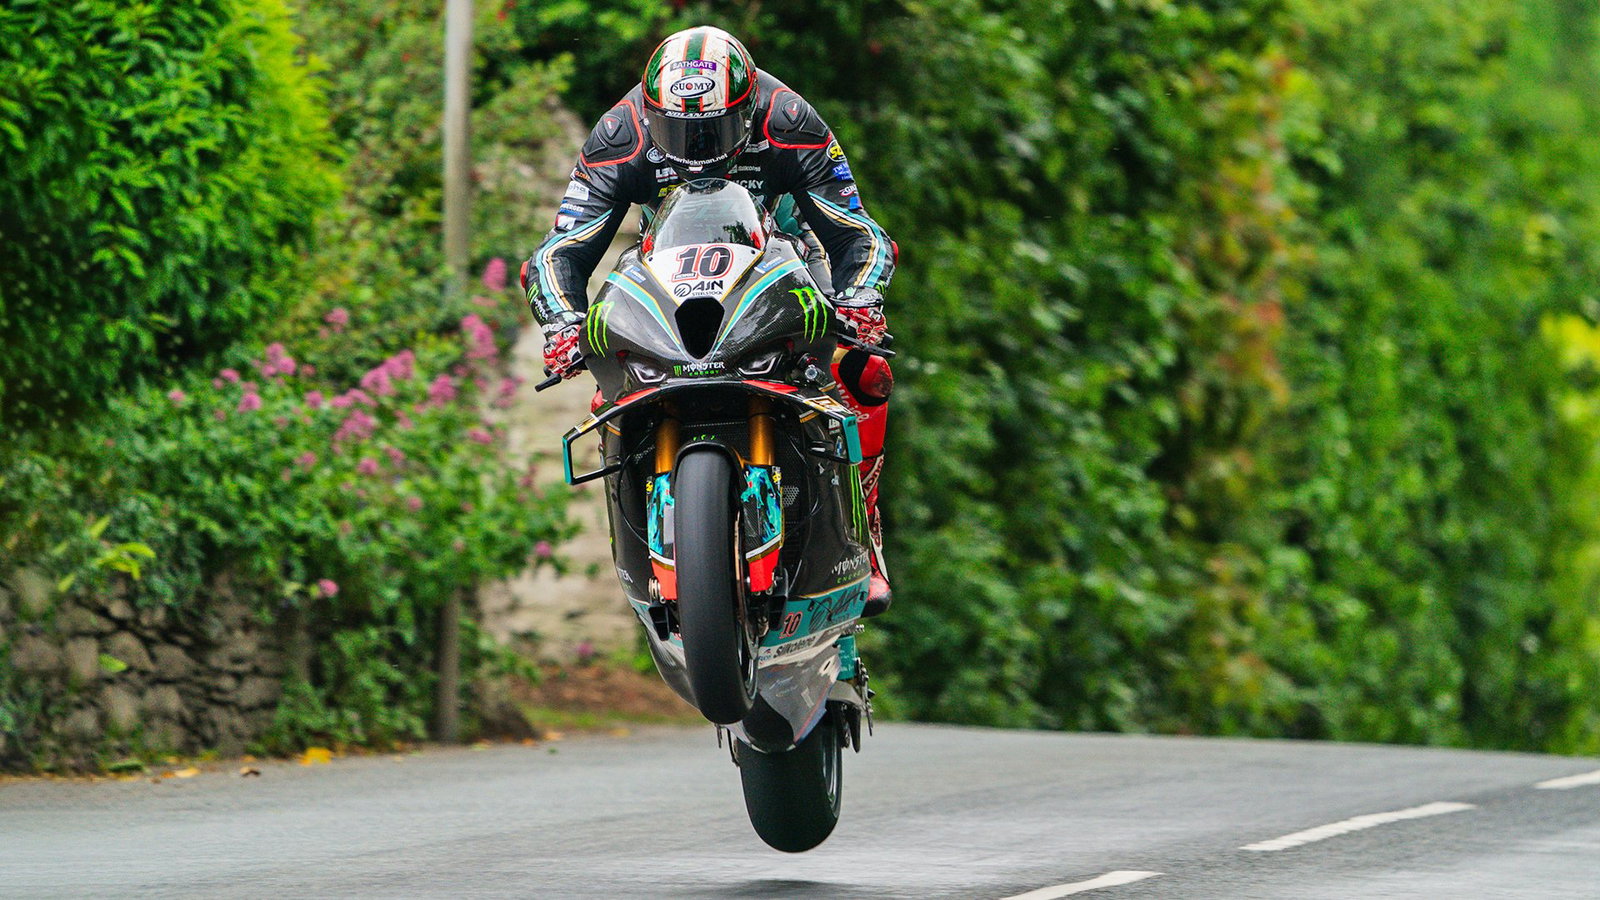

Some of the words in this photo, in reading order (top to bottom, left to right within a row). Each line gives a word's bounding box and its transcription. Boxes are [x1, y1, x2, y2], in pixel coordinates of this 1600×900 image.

[672, 60, 713, 69] BATHGATE
[673, 82, 712, 91] SUOMY
[665, 110, 702, 118] NOLAN
[703, 109, 727, 117] OILS
[666, 153, 728, 165] peterhickman.net
[673, 245, 733, 281] 10
[692, 280, 724, 291] AJN
[682, 361, 725, 372] MONSTER
[779, 611, 803, 639] 10
